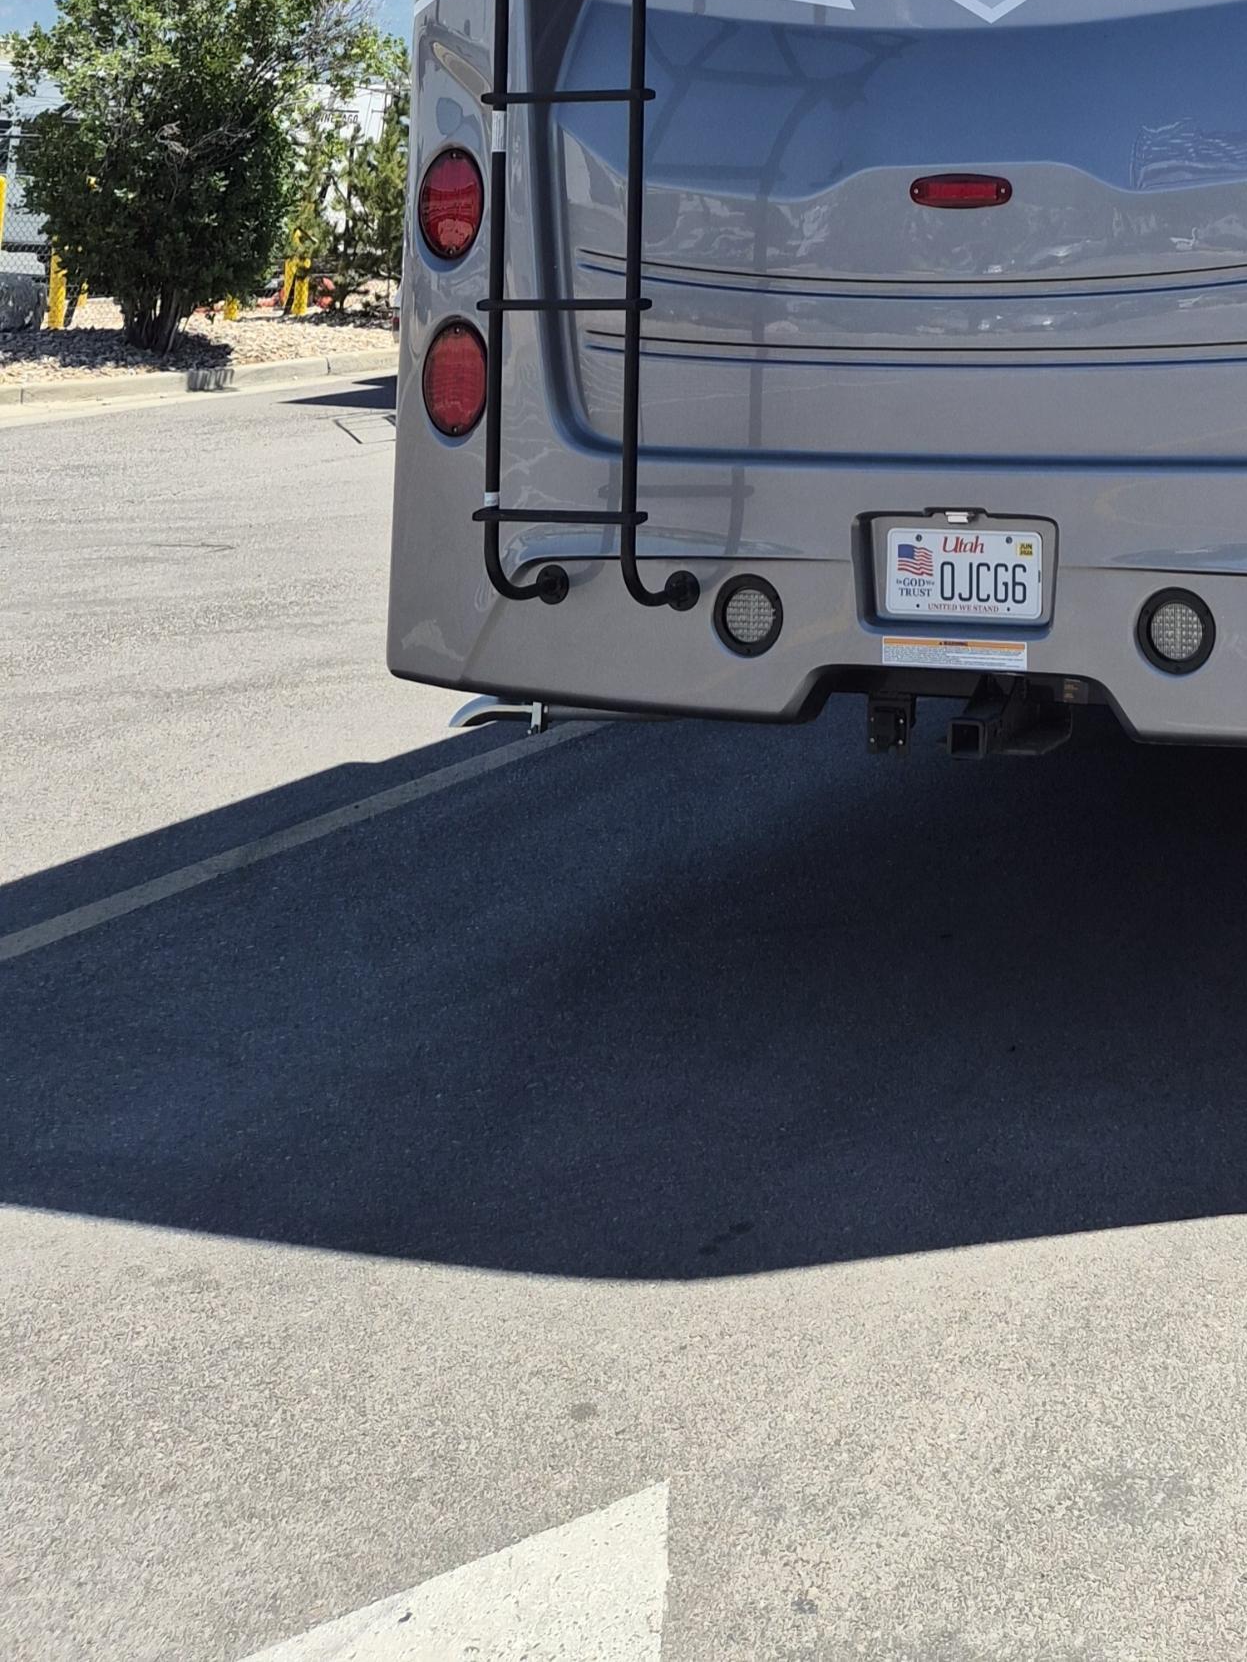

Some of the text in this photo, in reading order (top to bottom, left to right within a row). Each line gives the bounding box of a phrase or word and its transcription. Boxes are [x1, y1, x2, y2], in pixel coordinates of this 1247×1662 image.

[942, 535, 985, 554] Utah
[902, 577, 926, 587] GOD
[898, 587, 932, 597] TRUST
[927, 602, 999, 613] UNITED WE STAND
